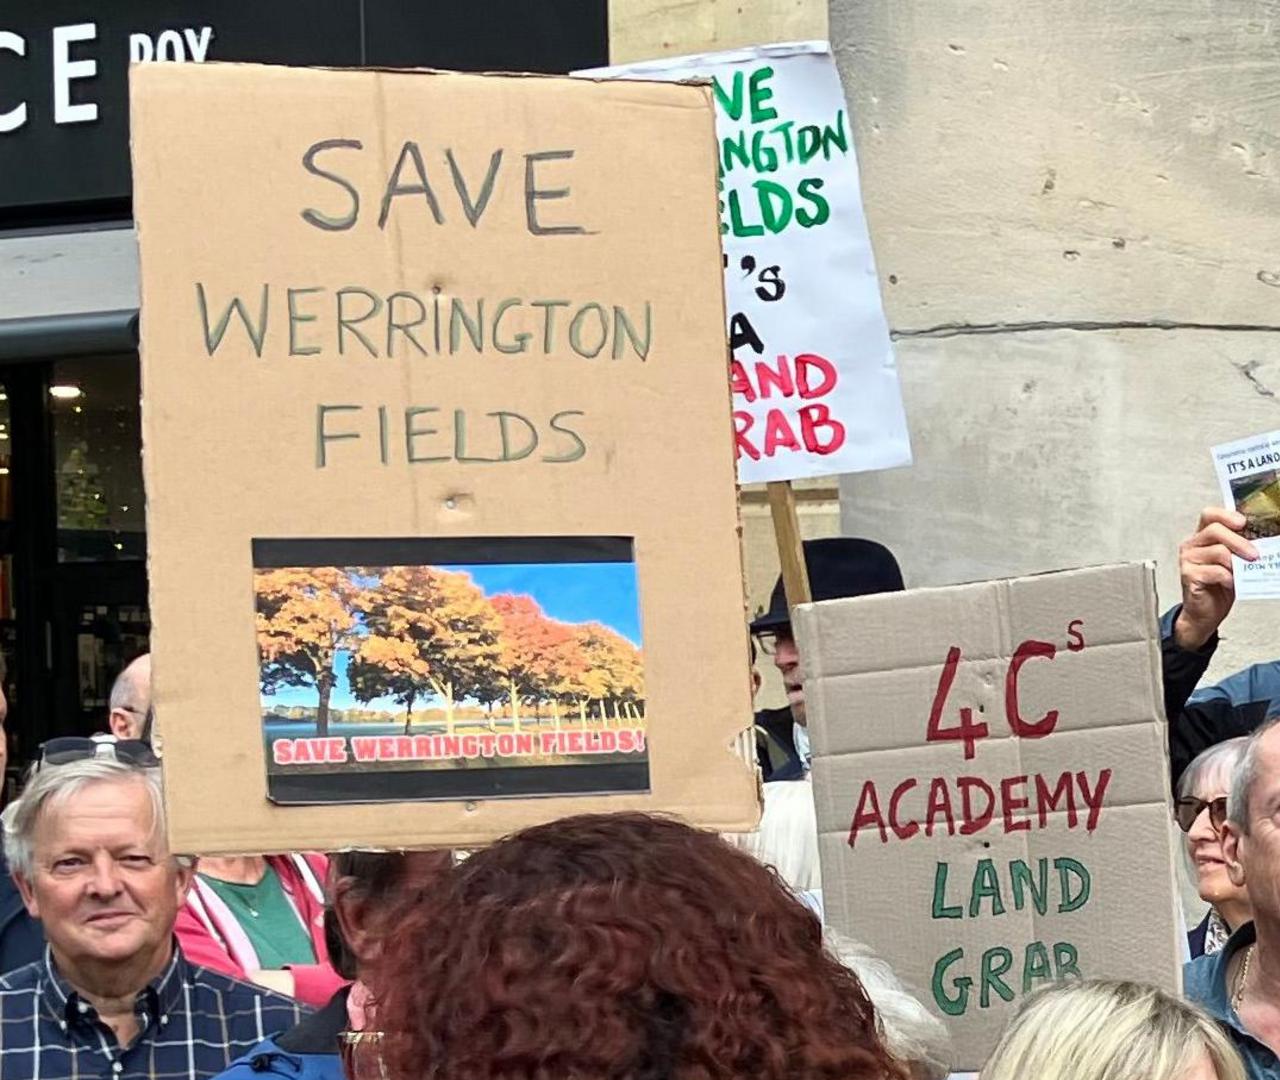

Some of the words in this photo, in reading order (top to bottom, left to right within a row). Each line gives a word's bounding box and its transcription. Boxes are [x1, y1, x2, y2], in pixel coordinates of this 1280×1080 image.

[301, 138, 598, 235] SAVE
[196, 282, 651, 361] WERRINGTON
[316, 404, 586, 467] FIELDS
[1256, 452, 1280, 467] LAND
[273, 738, 346, 764] SAVE
[352, 733, 532, 762] WERRINGTON
[540, 730, 645, 754] FIELDS!
[848, 768, 1112, 848] ACADEMY
[932, 857, 1092, 919] LAND
